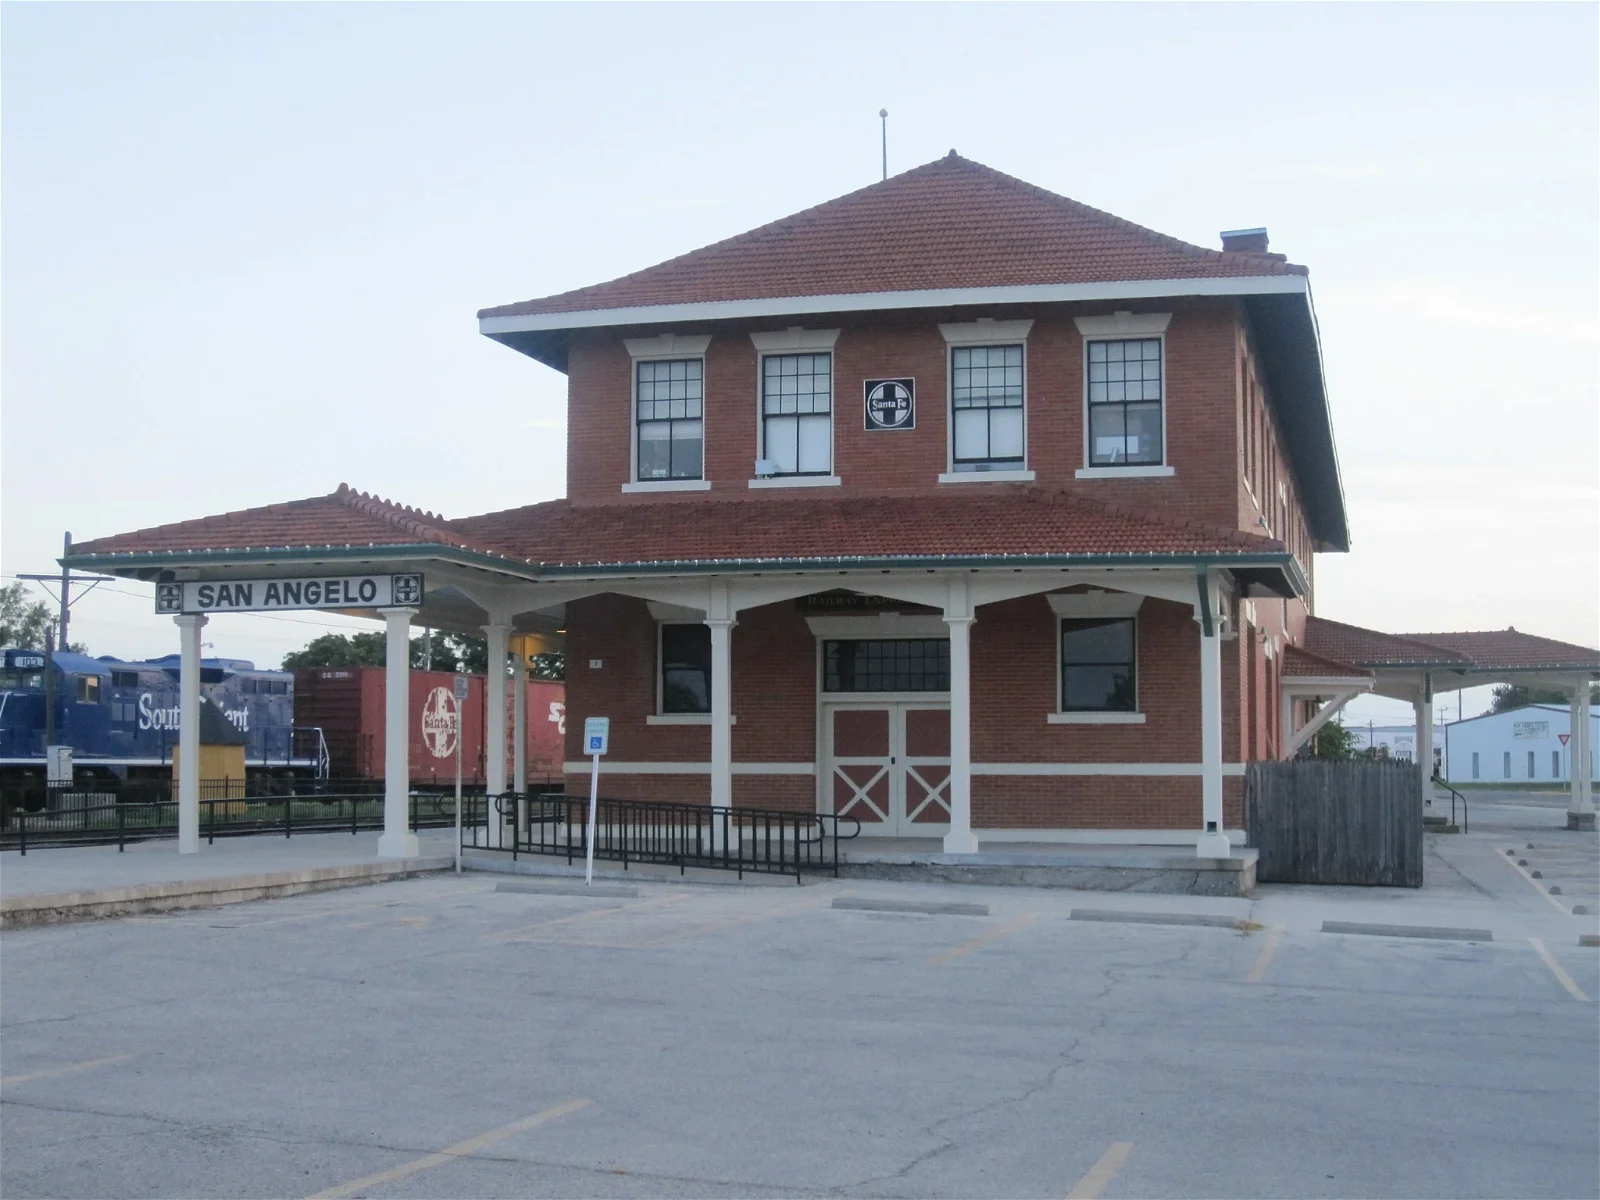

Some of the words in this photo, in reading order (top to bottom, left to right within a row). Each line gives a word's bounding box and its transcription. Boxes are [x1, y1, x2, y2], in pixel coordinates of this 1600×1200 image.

[872, 399, 896, 410] Santa
[897, 398, 907, 409] Fe
[197, 581, 253, 608] SAN
[263, 578, 377, 606] ANGELO
[22, 657, 38, 667] 103
[140, 692, 181, 731] Sout
[424, 714, 448, 730] Santa
